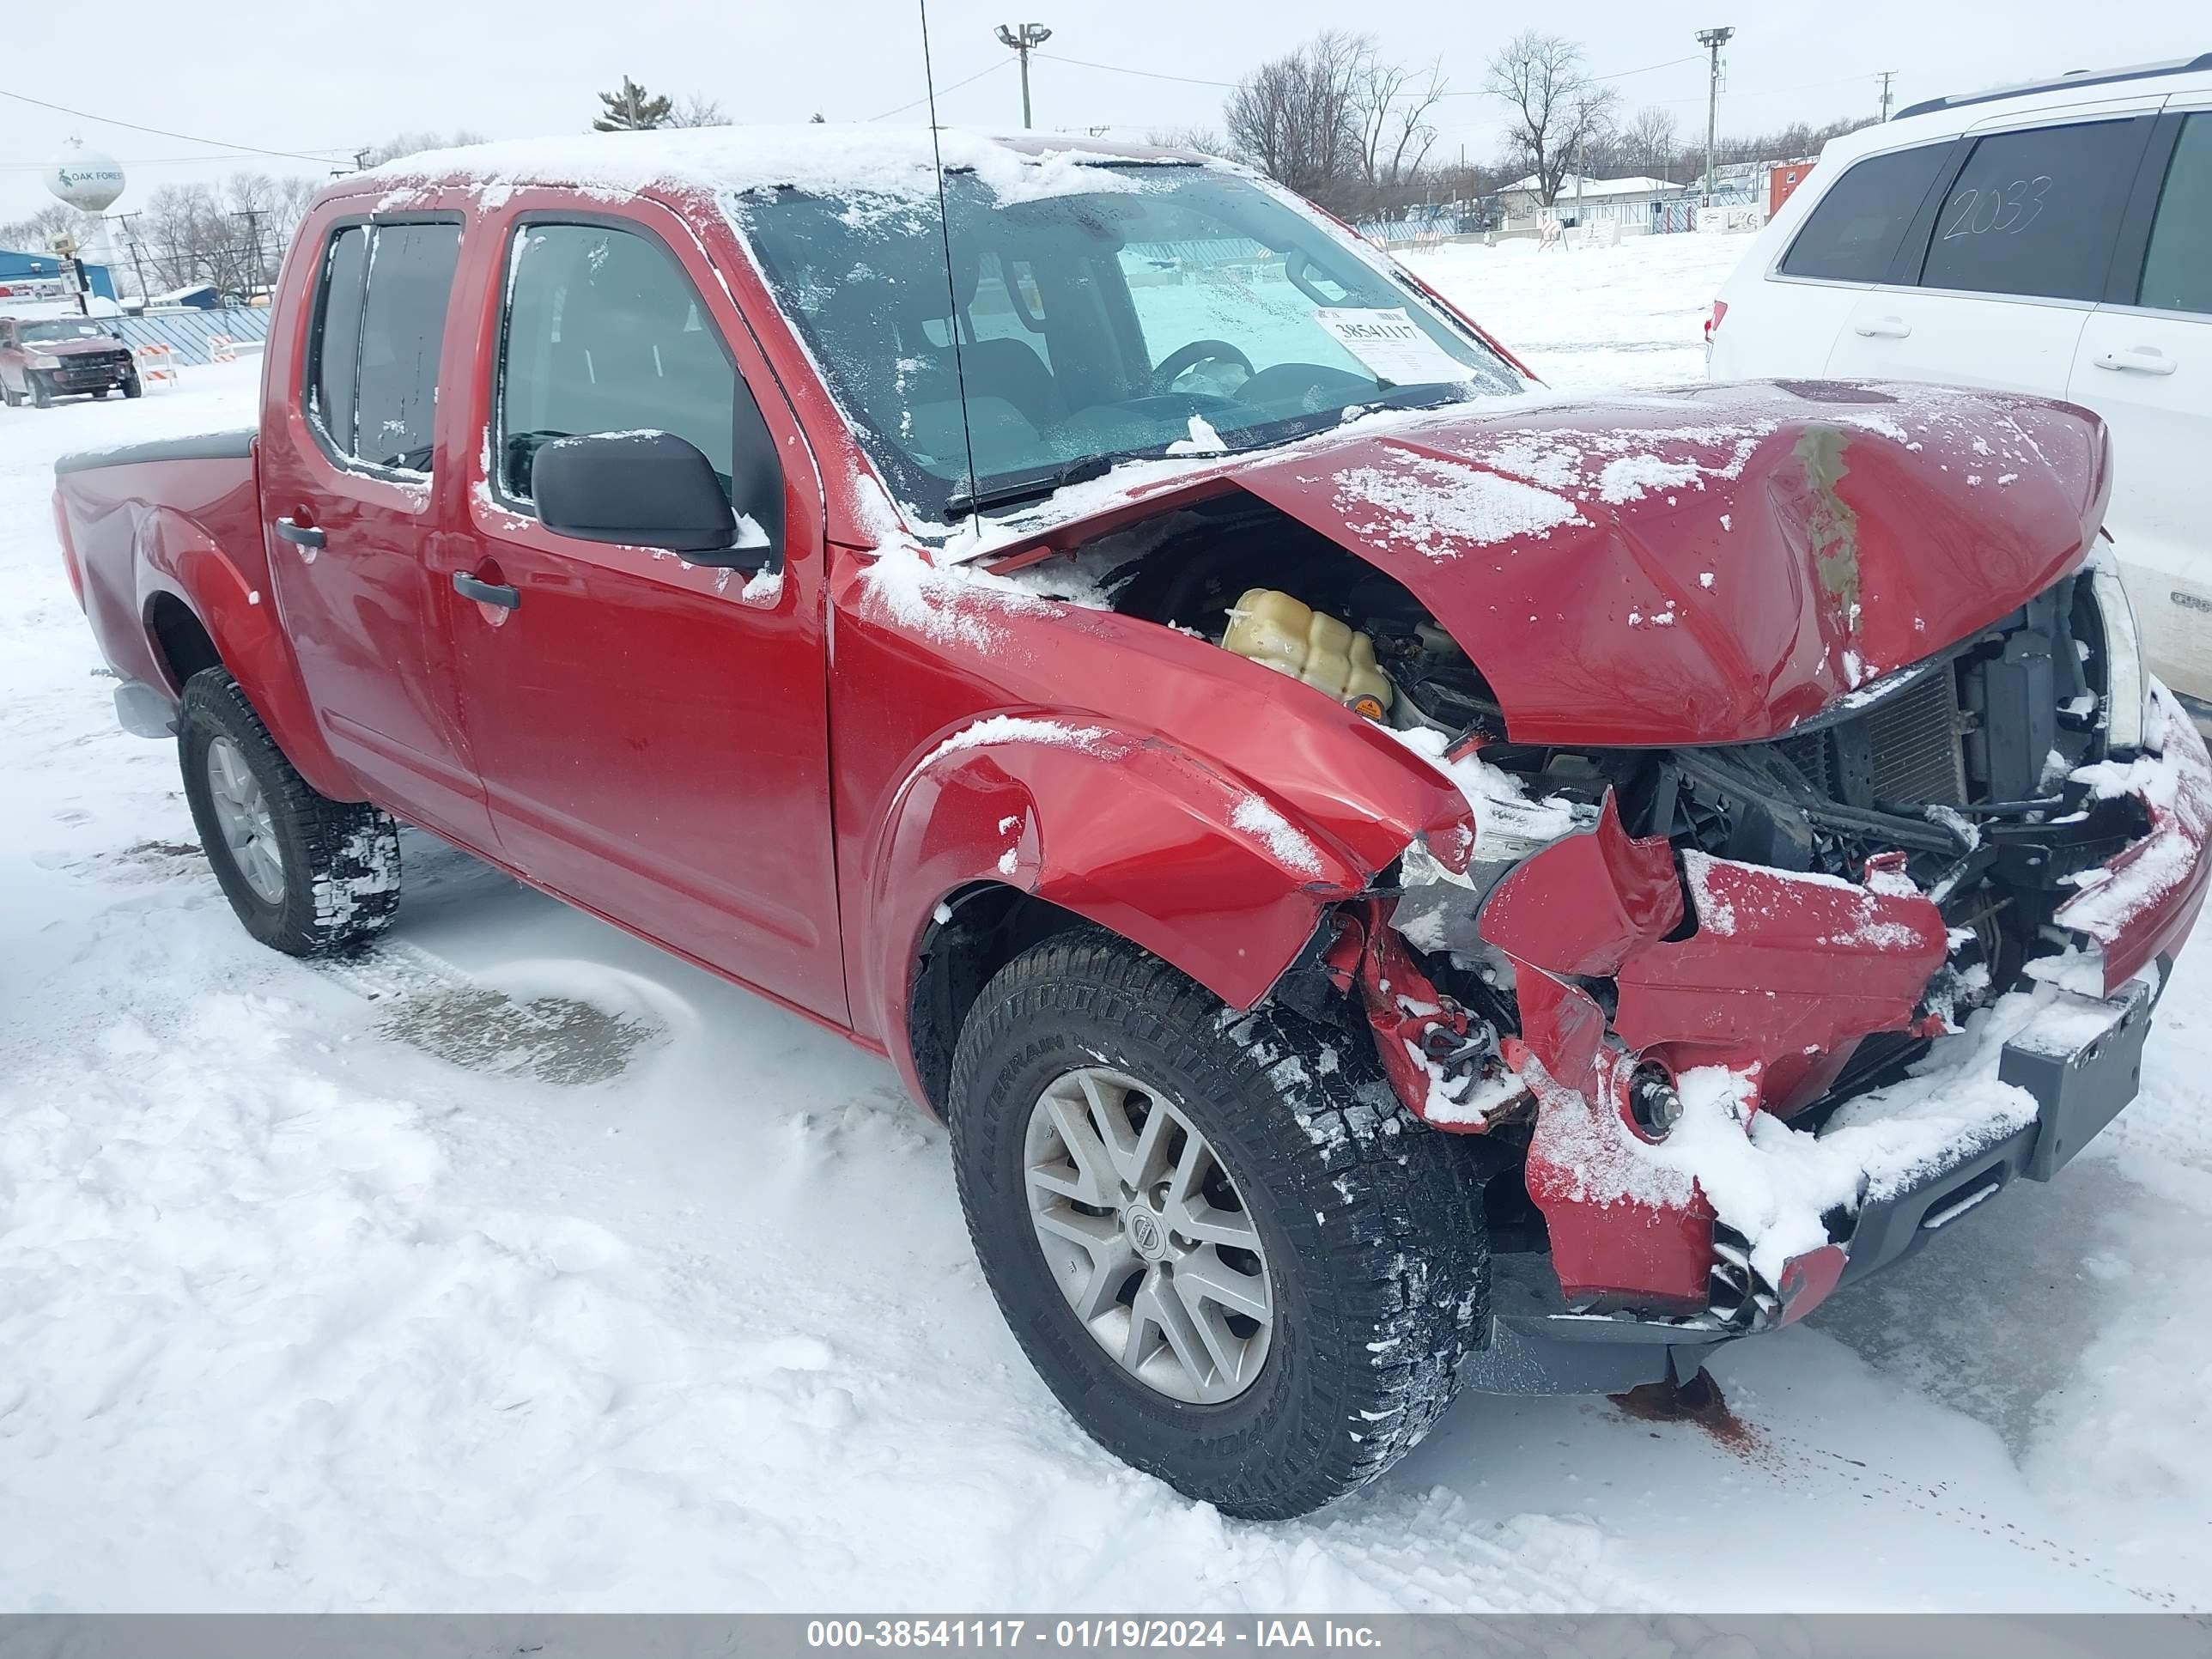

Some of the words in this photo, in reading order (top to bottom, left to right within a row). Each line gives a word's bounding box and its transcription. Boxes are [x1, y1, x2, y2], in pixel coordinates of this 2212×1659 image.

[1944, 175, 2052, 240] 2033
[1335, 325, 1418, 338] 38541117
[984, 1034, 1066, 1122] TERRAIN
